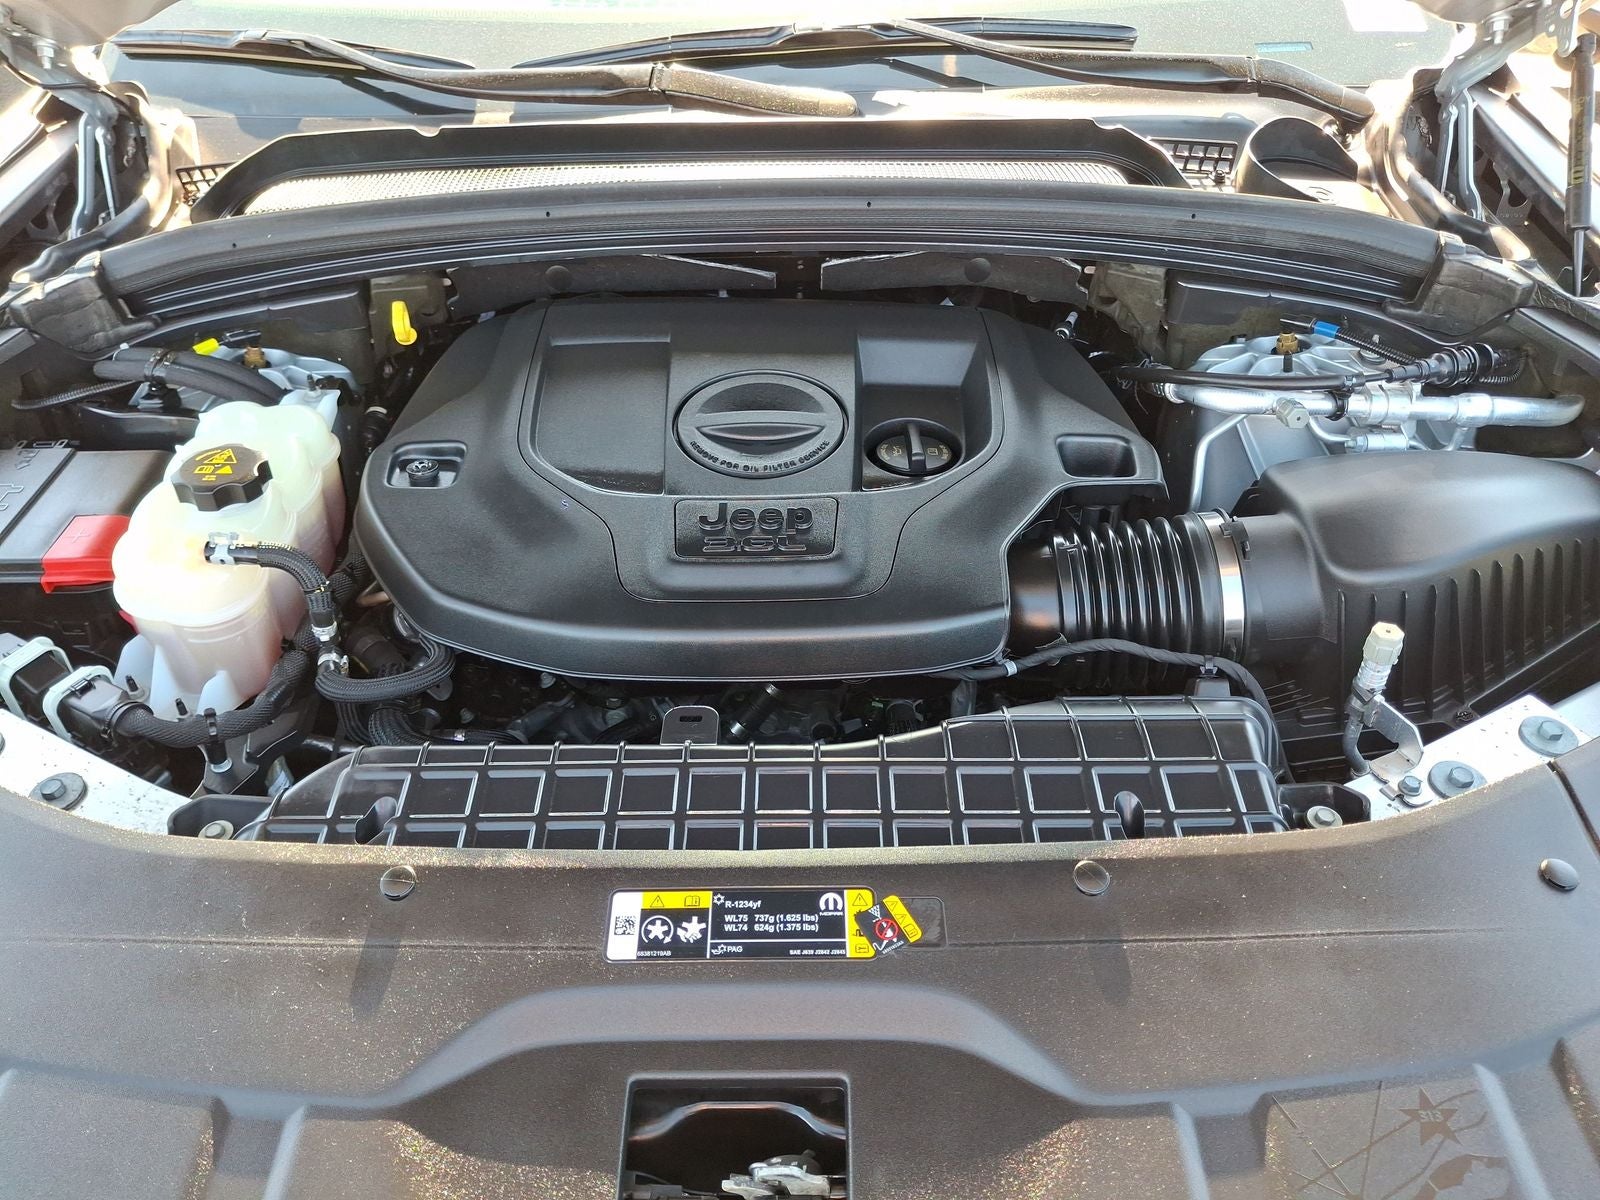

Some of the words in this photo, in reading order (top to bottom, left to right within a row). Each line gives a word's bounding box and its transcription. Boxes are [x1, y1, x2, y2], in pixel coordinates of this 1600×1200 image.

[690, 441, 719, 463] REMOVE
[720, 460, 740, 470] FOR
[743, 464, 759, 472] OIL
[763, 460, 797, 472] FILTER
[798, 440, 830, 464] SERVICE
[699, 502, 813, 535] Jeep
[703, 535, 807, 552] 3.6L
[724, 900, 762, 909] R-1234yf
[724, 914, 749, 923] WL75
[754, 914, 775, 924] 737g
[776, 914, 801, 923] (1.625
[802, 913, 819, 923] lbs)
[724, 924, 748, 932] WL74
[754, 924, 775, 933] 624g
[776, 923, 801, 932] (1.375
[802, 923, 819, 932] lbs)
[727, 945, 743, 953] PAG
